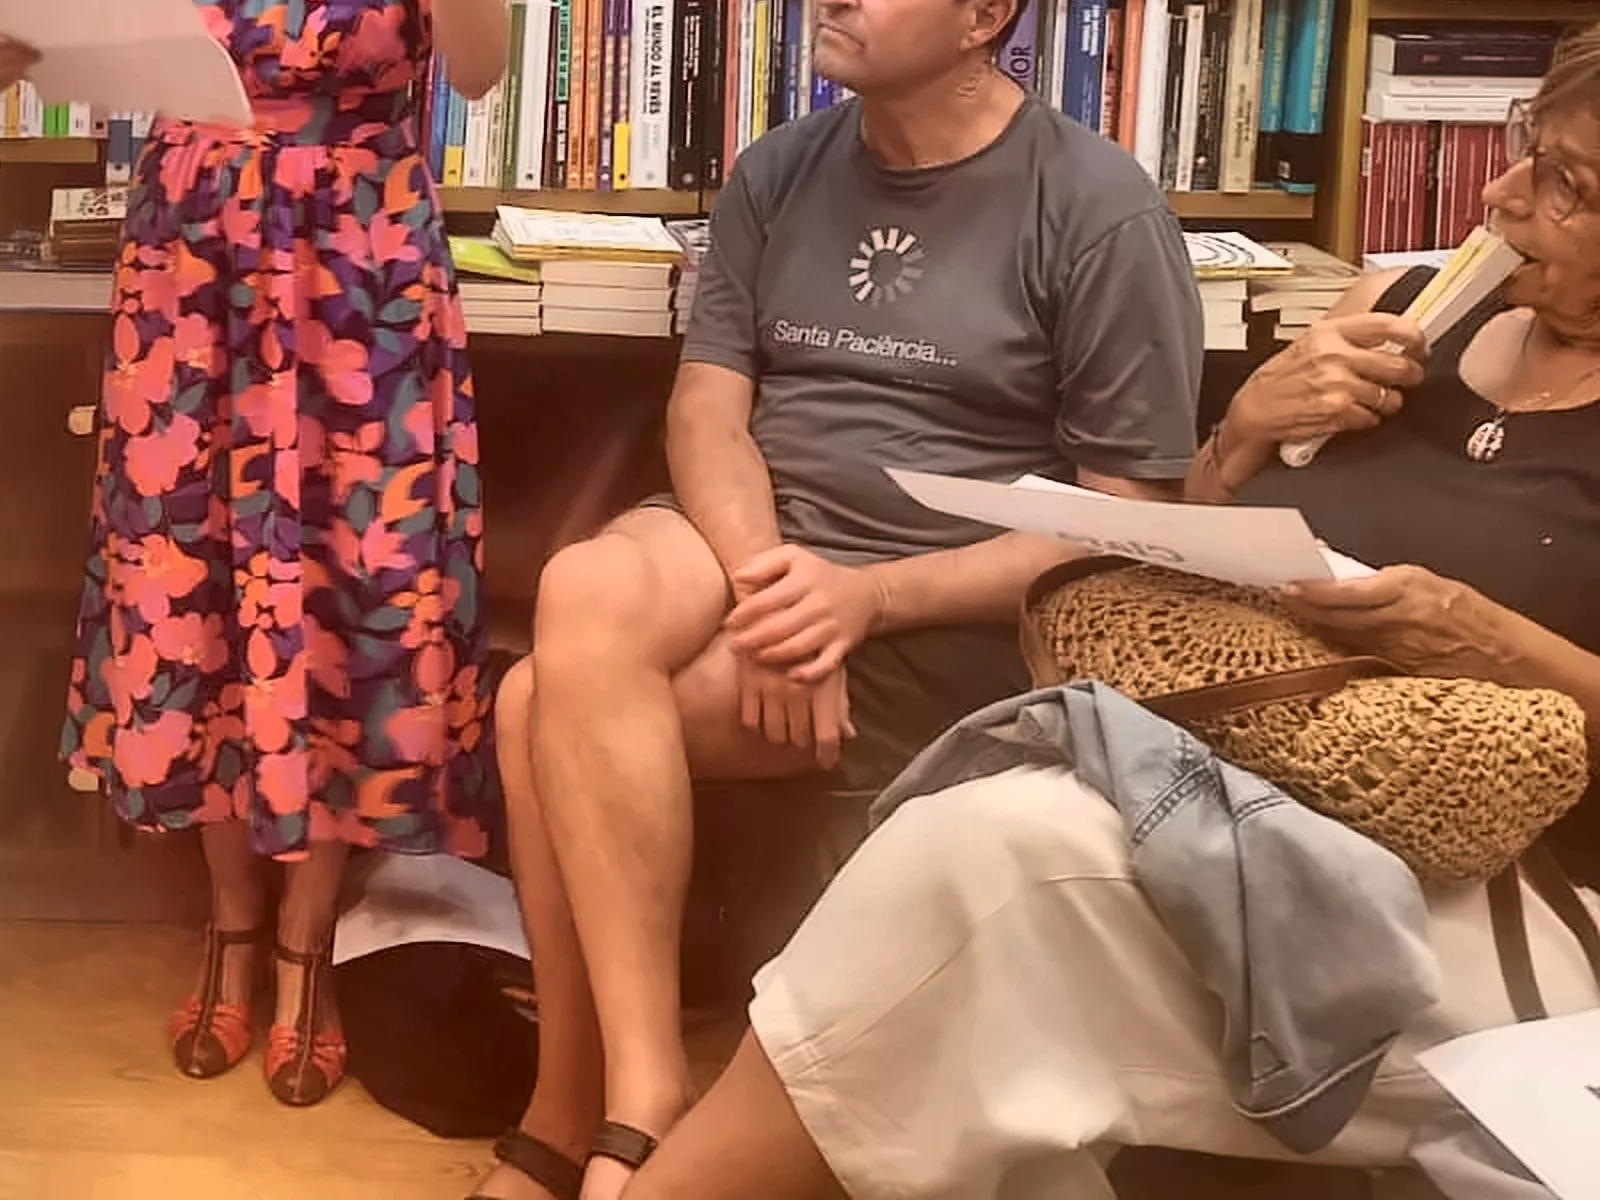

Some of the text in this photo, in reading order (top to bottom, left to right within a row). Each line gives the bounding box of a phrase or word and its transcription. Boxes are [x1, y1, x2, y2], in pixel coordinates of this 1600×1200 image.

[649, 5, 664, 115] EL MUNDO AL REVÉS
[773, 319, 831, 349] Santa
